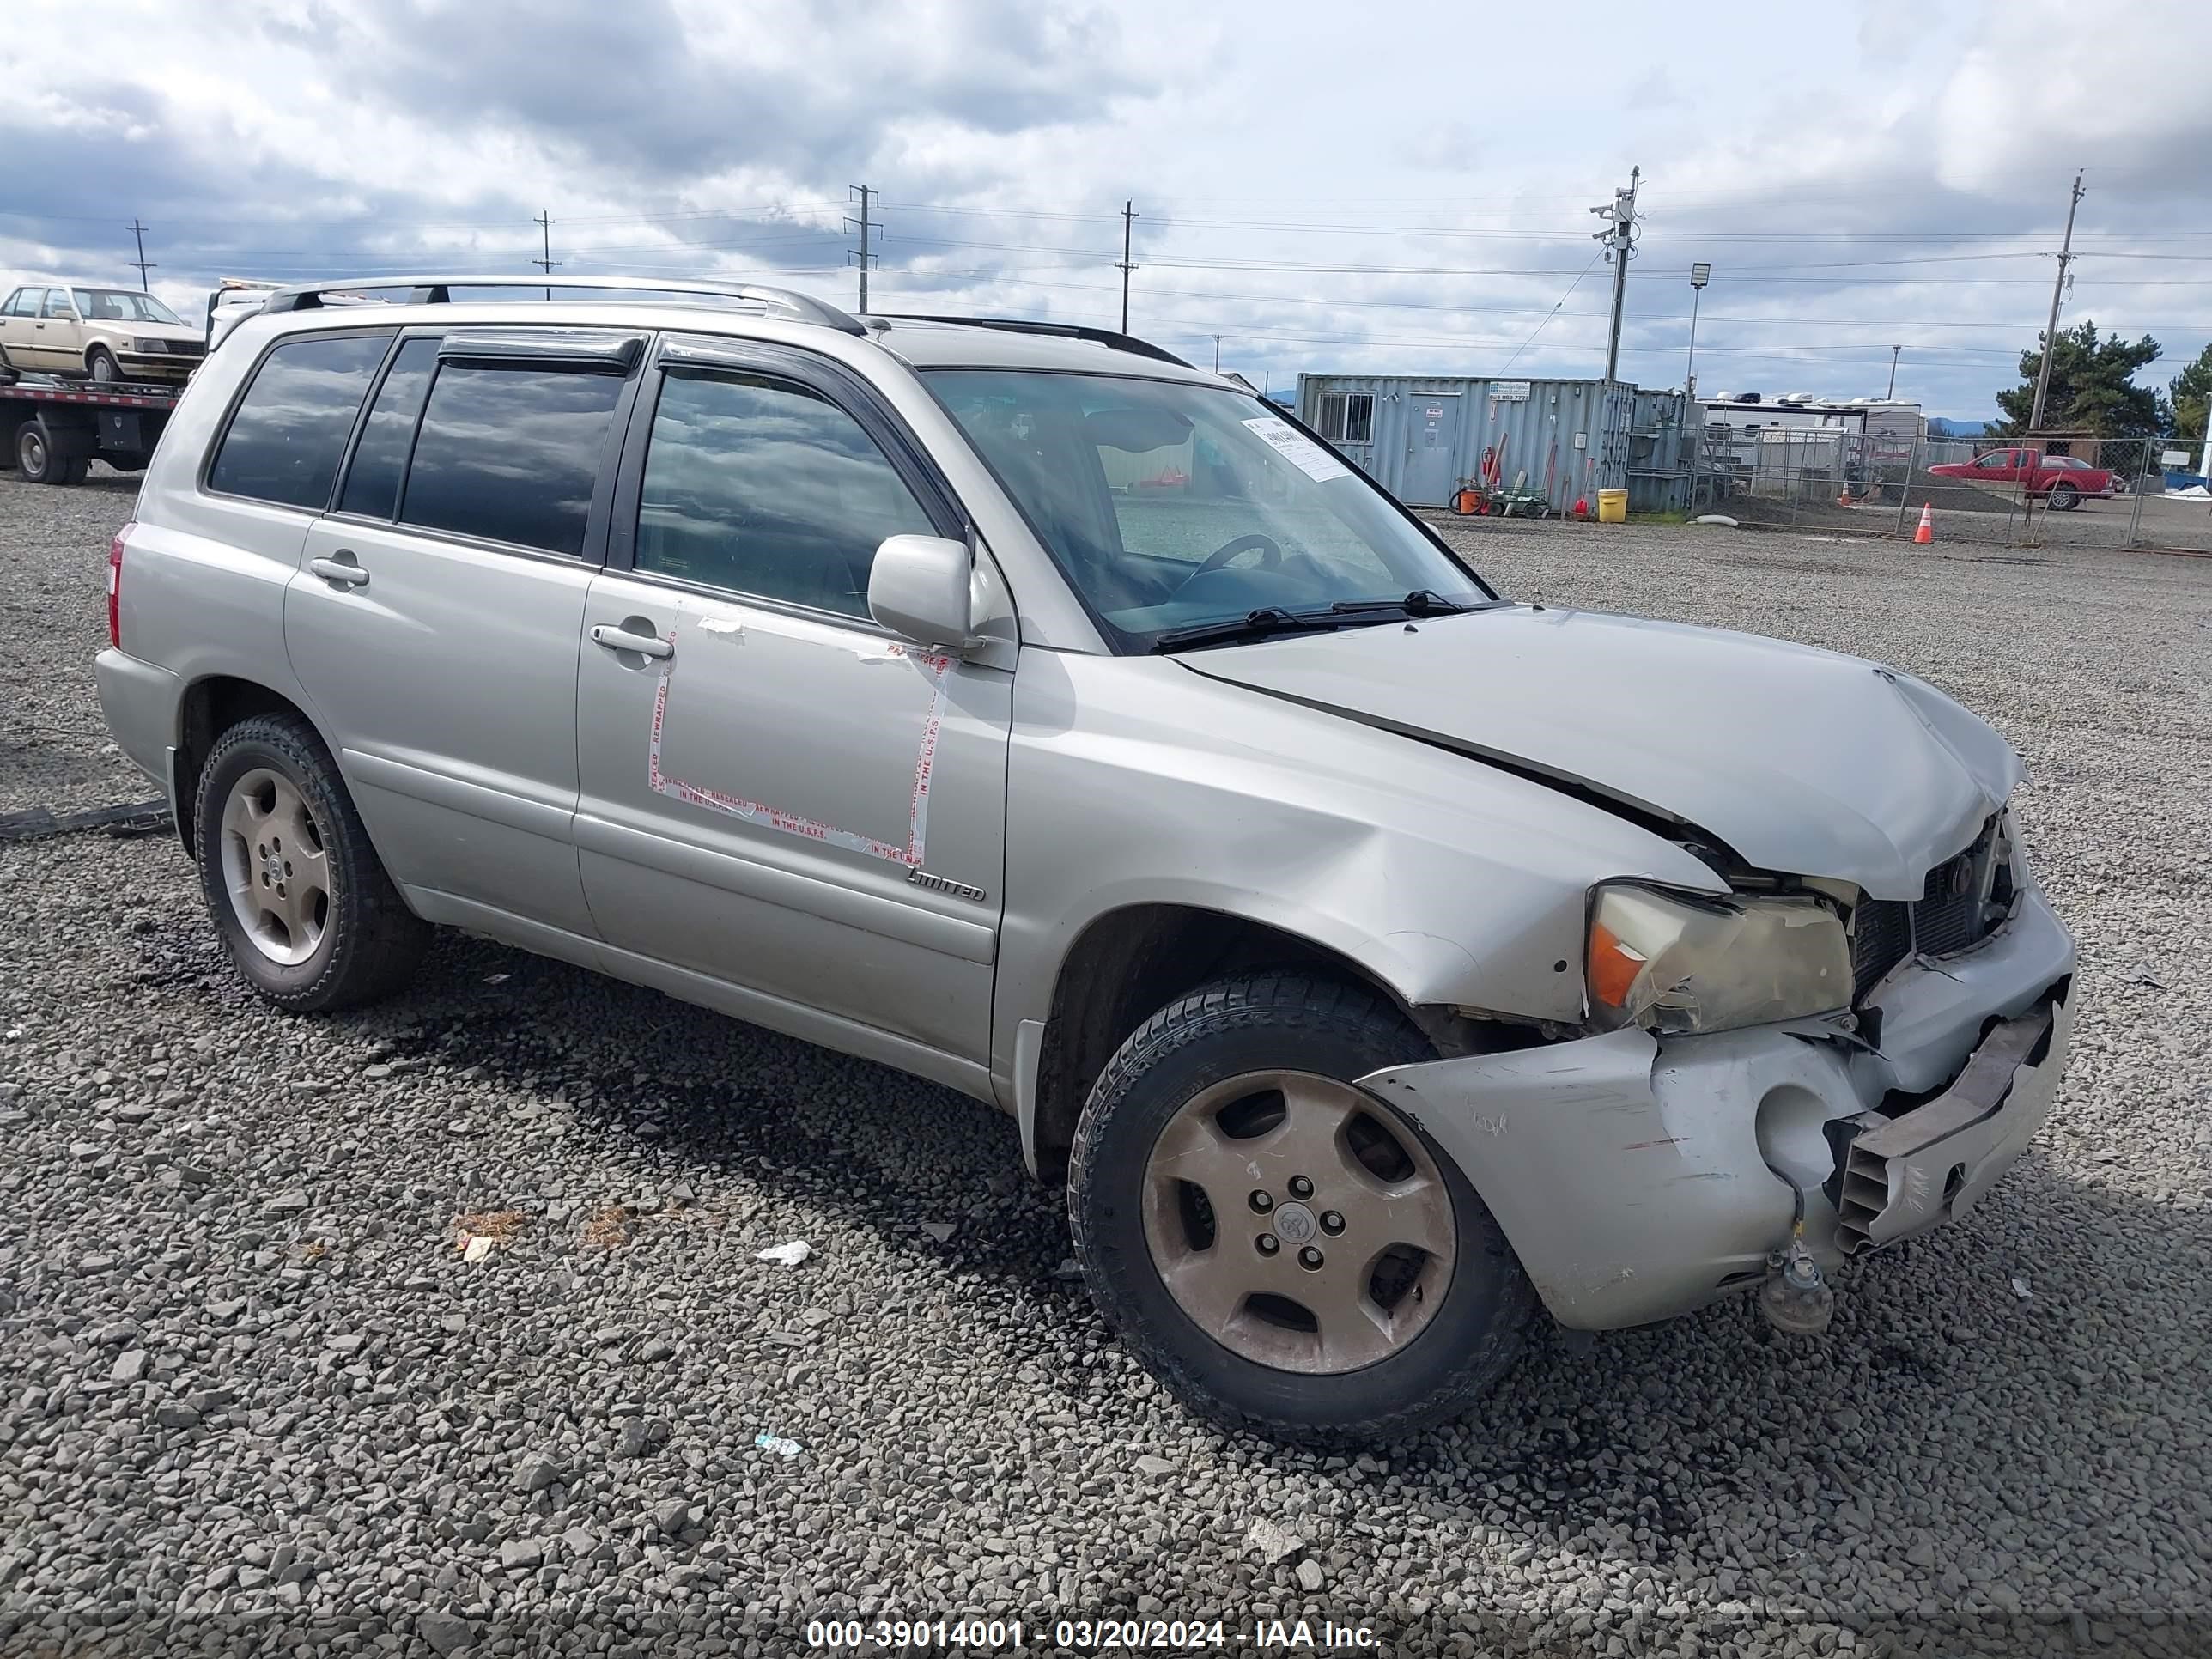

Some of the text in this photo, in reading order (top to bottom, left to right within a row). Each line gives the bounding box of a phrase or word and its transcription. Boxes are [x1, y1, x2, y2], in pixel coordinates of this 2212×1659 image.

[653, 685, 666, 744] REWRAPPED
[920, 717, 940, 796] IN THE U.S.P.S.
[679, 789, 688, 799] IN
[690, 793, 703, 804] THE
[772, 818, 781, 827] IN
[782, 821, 797, 831] THE
[799, 823, 828, 840] U.S.P.S.
[871, 844, 879, 853] IN
[882, 848, 897, 860] THE
